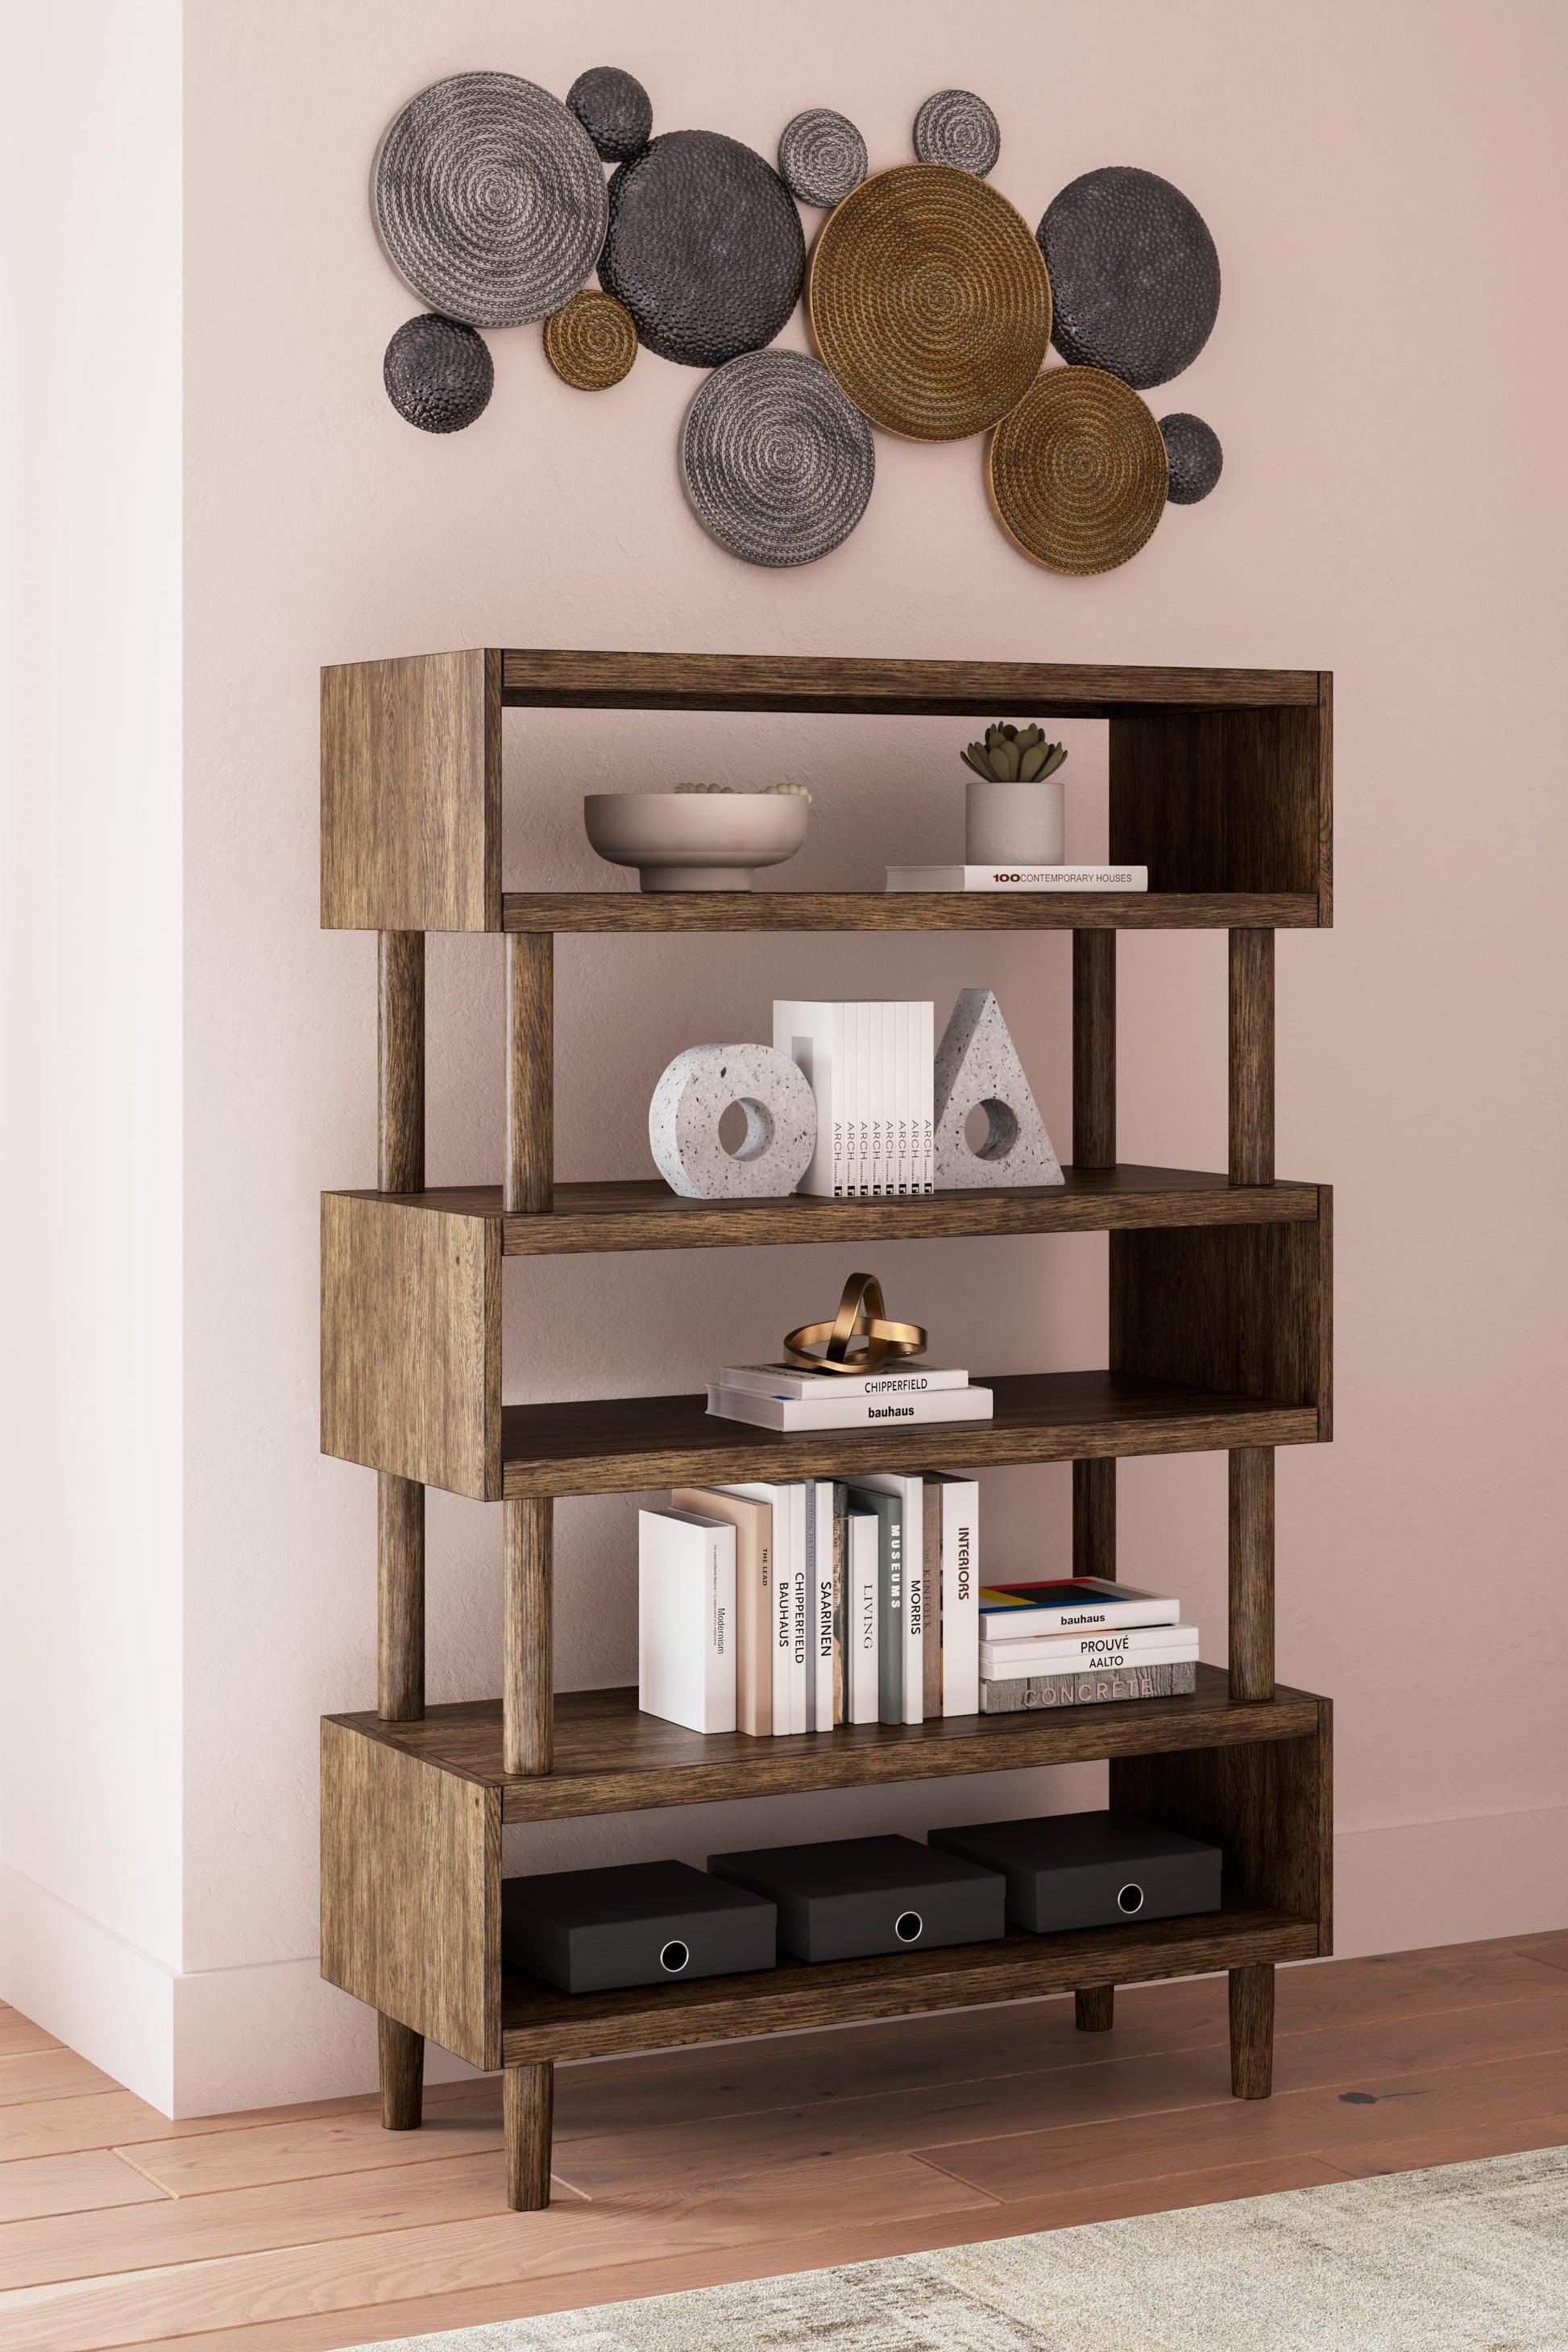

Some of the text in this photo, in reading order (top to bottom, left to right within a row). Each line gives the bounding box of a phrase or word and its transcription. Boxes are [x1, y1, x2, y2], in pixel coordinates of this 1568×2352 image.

[1096, 873, 1132, 883] HOUSES
[834, 1122, 842, 1160] ARCH
[847, 1122, 855, 1159] ARCH
[865, 1379, 928, 1393] CHIPPERFIELD
[868, 1405, 915, 1419] bauhaus
[890, 1524, 901, 1608] MUSEUMS
[958, 1527, 970, 1600] INTERIORS
[778, 1582, 789, 1647] BAUHAUS
[794, 1572, 805, 1664] CHIPPERFIELD
[864, 1584, 873, 1649] LIVING
[911, 1579, 921, 1635] MORRIS
[923, 1570, 931, 1630] KINFOLK
[820, 1582, 832, 1657] SAARINEN
[1060, 1614, 1105, 1626] bauhaus
[1081, 1635, 1130, 1653] PROUVÉ
[1089, 1655, 1124, 1669] AALTO
[1023, 1678, 1152, 1707] CONCRETE
